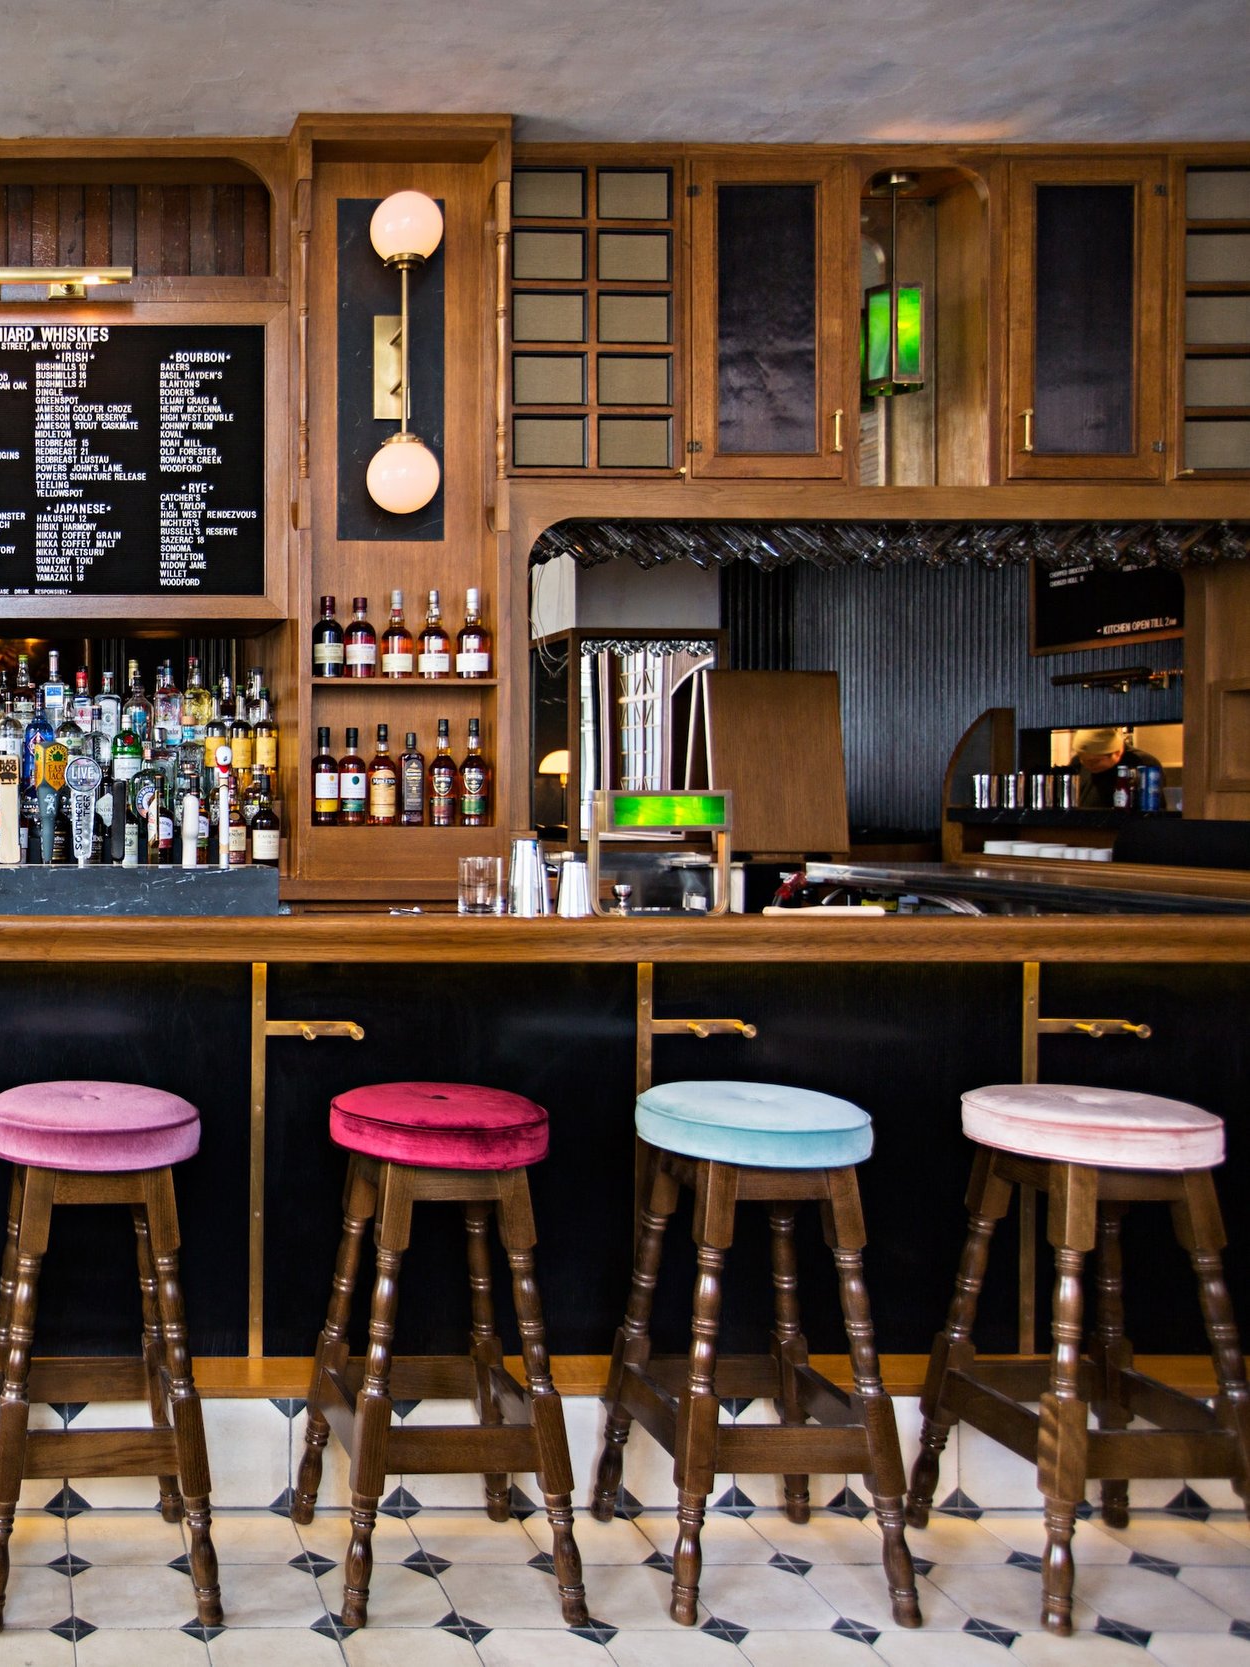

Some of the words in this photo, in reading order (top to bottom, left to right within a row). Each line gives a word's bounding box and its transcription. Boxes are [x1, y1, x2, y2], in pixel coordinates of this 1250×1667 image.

[40, 327, 109, 342] WHISKIES
[1, 343, 30, 351] STREET,
[61, 352, 88, 363] IRISH
[175, 352, 225, 363] BOURBON
[160, 363, 190, 371] BAKERS
[160, 371, 181, 380] BASIL
[185, 371, 222, 379] HAYDEN'S
[12, 381, 27, 390] OAK
[36, 380, 76, 388] BUSHMILLS
[78, 380, 86, 388] 21
[160, 380, 200, 388] BLANTONS
[36, 388, 63, 396] DINGLE
[160, 388, 194, 396] BOOKERS
[35, 396, 79, 404] GREENSPOT
[35, 404, 70, 413] JAMESON
[73, 405, 104, 413] COOPER
[107, 405, 132, 413] CROZE
[160, 405, 184, 413] HENRY
[187, 405, 222, 413] MCKENNA
[35, 413, 70, 421] JAMESON
[72, 413, 92, 421] GOLD
[96, 413, 127, 421] RESERVE
[180, 414, 202, 422] WEST
[204, 414, 234, 422] DOUBLE
[35, 422, 70, 430] JAMESON
[74, 422, 98, 430] STOUT
[101, 422, 138, 430] CASKMATE
[160, 422, 189, 430] JOHNNY
[192, 422, 213, 430] DRUM
[35, 430, 72, 438] MIDLETON
[160, 430, 183, 438] KOVAL
[160, 439, 180, 447] NOAH
[184, 439, 202, 447] MILL
[160, 448, 175, 456] OLD
[179, 448, 216, 456] FORESTER
[36, 456, 77, 464] REDBREAST
[80, 456, 109, 464] LUSTAU
[160, 456, 194, 464] ROWAN'S
[196, 456, 222, 464] CREEK
[36, 464, 67, 472] POWERS
[72, 464, 99, 472] JOHN'S
[103, 464, 122, 472] LANE
[160, 464, 202, 472] WOODFORD
[36, 472, 67, 480] POWERS
[70, 472, 112, 480] SIGNATURE
[114, 472, 146, 480] RELEASE
[36, 481, 69, 489] TEELING
[189, 483, 207, 493] RYE
[36, 489, 83, 497] YELLOWSPOT
[160, 494, 201, 502] CATCHER'S
[54, 504, 106, 514] JAPANESE
[160, 510, 178, 518] HIGH
[182, 510, 202, 518] WEST
[207, 510, 256, 518] RENDEZVOUS
[62, 523, 97, 531] HARMONY
[160, 519, 199, 527] MICHTER'S
[62, 531, 90, 539] COFFEY
[206, 528, 238, 536] RESERVE
[61, 540, 91, 548] COFFEY
[96, 540, 116, 548] MALT
[160, 544, 191, 552] SONOMA
[36, 548, 58, 556] NIKKA
[61, 548, 104, 556] TAKETSURU
[36, 565, 72, 573] YAMAZAKI
[76, 565, 84, 573] 12
[160, 561, 186, 569] WIDOW
[189, 561, 206, 569] JANE
[160, 578, 200, 586] WOODFORD
[1103, 623, 1131, 635] KITCHEN
[1132, 620, 1150, 631] OPEN
[1150, 619, 1164, 628] TILL
[0, 764, 17, 772] HOG
[72, 767, 95, 779] LIVE
[83, 795, 91, 816] TIER
[75, 794, 83, 850] SOUTHERN
